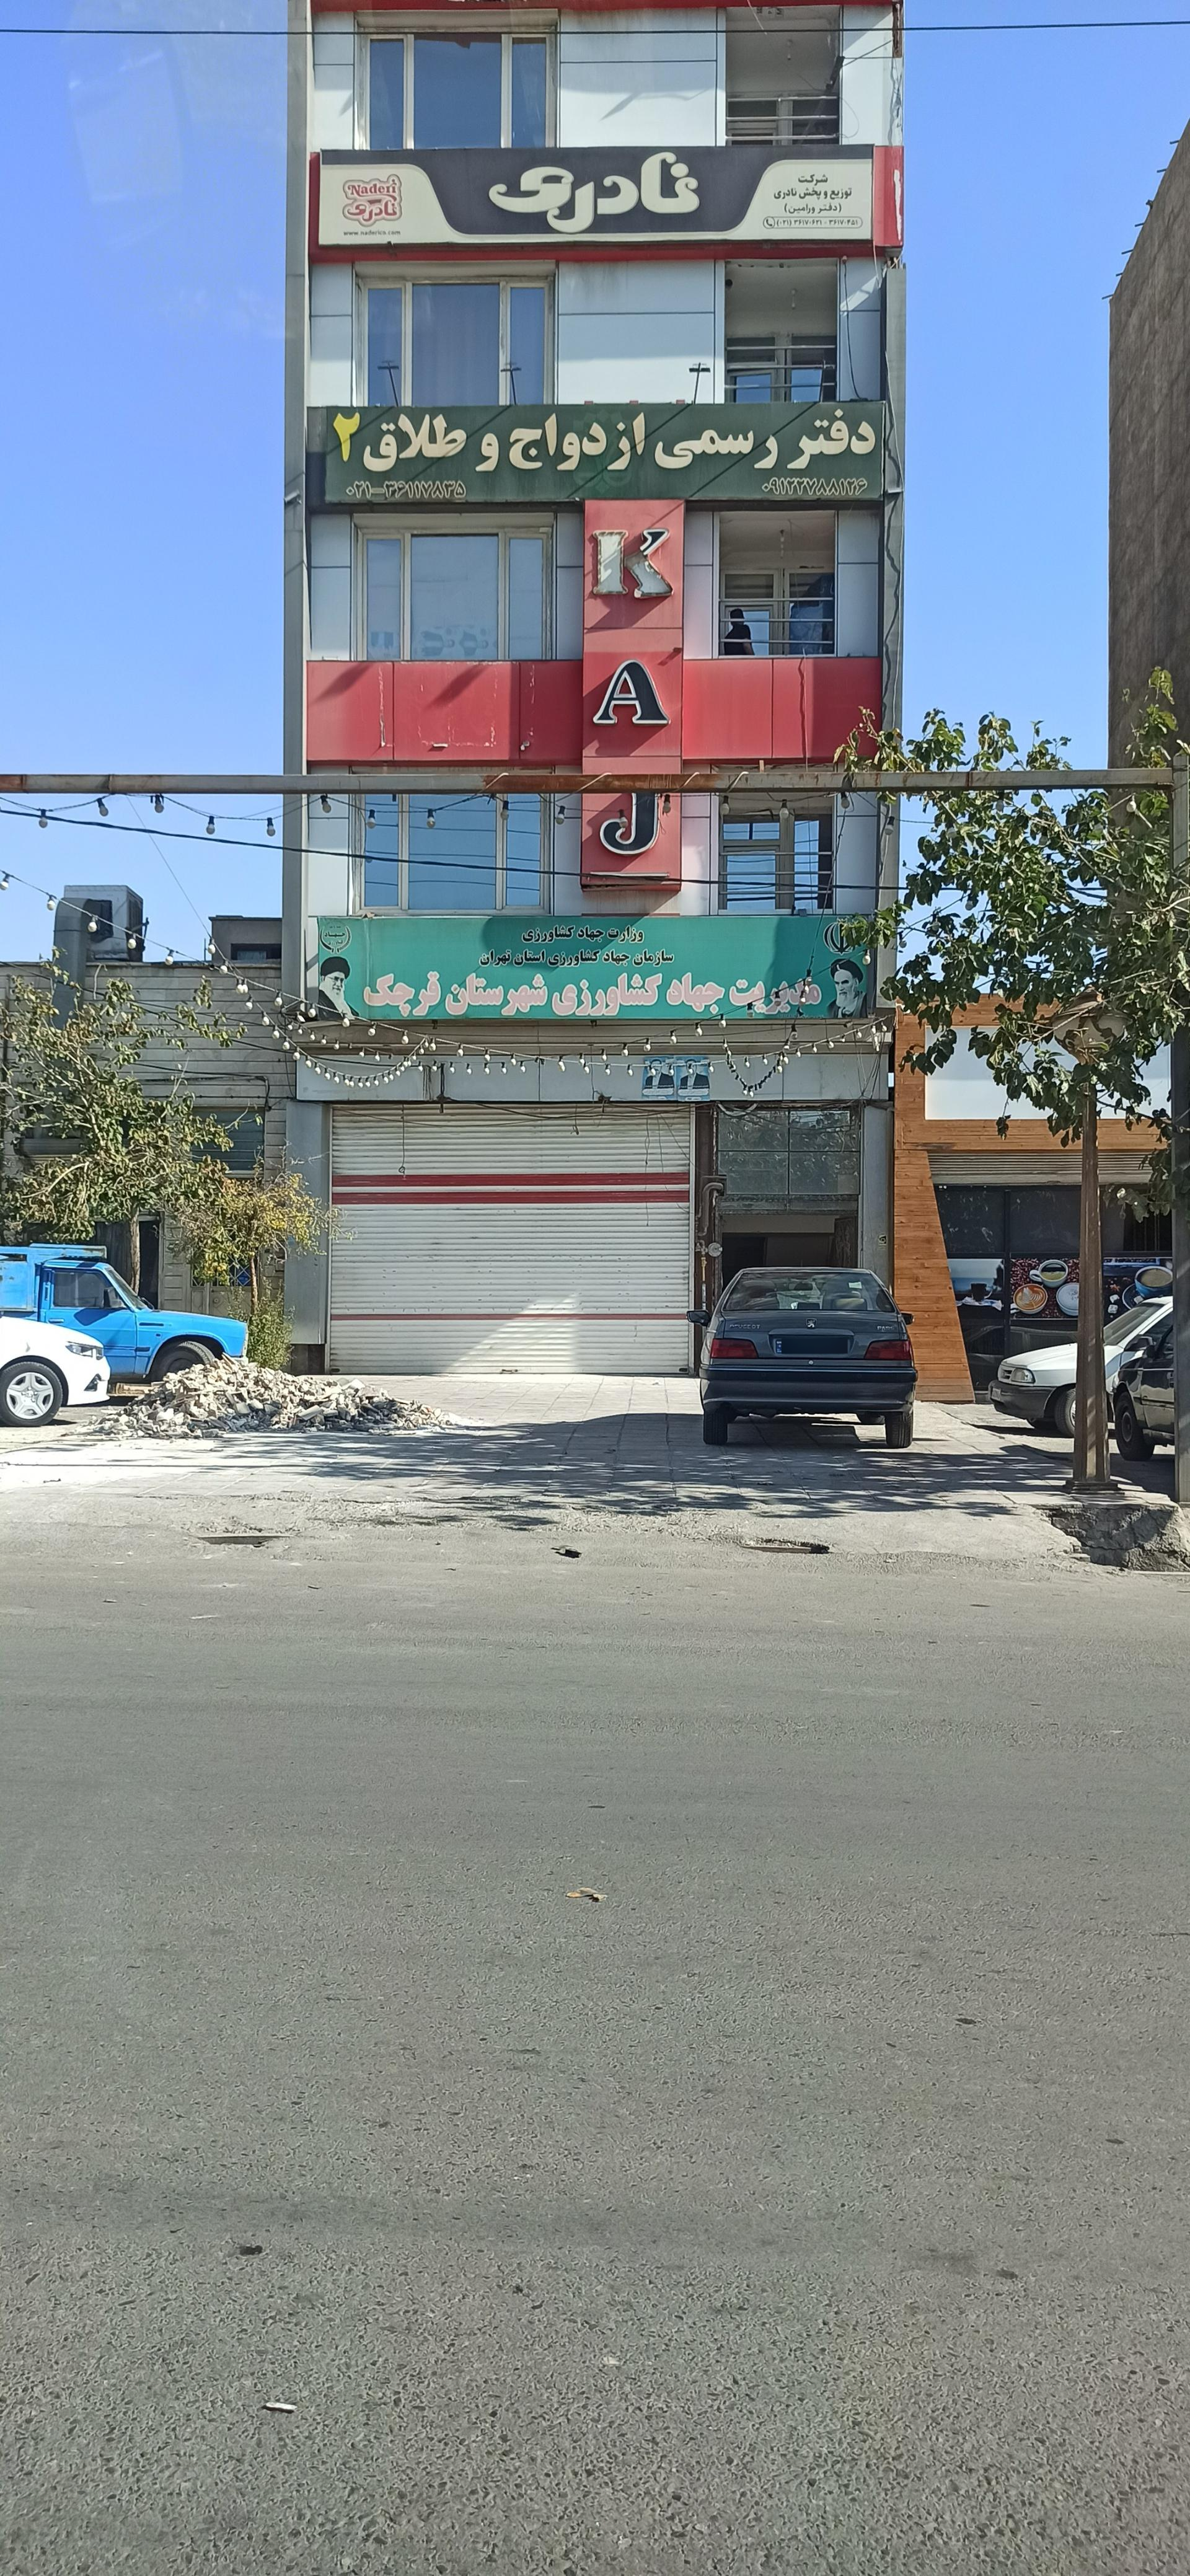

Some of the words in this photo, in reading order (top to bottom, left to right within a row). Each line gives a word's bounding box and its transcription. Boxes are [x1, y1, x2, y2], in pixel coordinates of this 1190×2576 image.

[798, 174, 828, 185] شرکت
[347, 179, 397, 201] Naderi
[488, 152, 700, 233] نادری
[774, 188, 797, 200] نادری
[798, 187, 822, 200] پخش
[823, 191, 828, 200] و
[829, 188, 852, 200] توزیع
[347, 199, 397, 222] نادری
[784, 203, 816, 214] ورامین)
[818, 203, 842, 213] (دفتر
[333, 412, 360, 462] ۲
[363, 413, 467, 472] طلاق
[509, 412, 646, 470] ازدواج
[787, 408, 876, 469] دفتر
[475, 433, 500, 472] و
[654, 428, 778, 469] رسمی
[762, 477, 868, 495] ۰۹۱۲۲۷۸۸۱۲۶
[522, 925, 575, 943] کشاورزی
[577, 925, 605, 942] جهاد
[607, 925, 645, 943] وزارت
[478, 950, 511, 966] تهران
[513, 950, 546, 966] استان
[547, 949, 601, 967] کشاورزی
[602, 949, 630, 966] جهاد
[632, 948, 674, 966] سازمان
[363, 971, 442, 1017] قرچک
[445, 973, 548, 1015] شهرستان
[552, 972, 663, 1017] کشاورزی
[666, 972, 725, 1015] جهاد
[729, 978, 822, 1015] مدیریت
